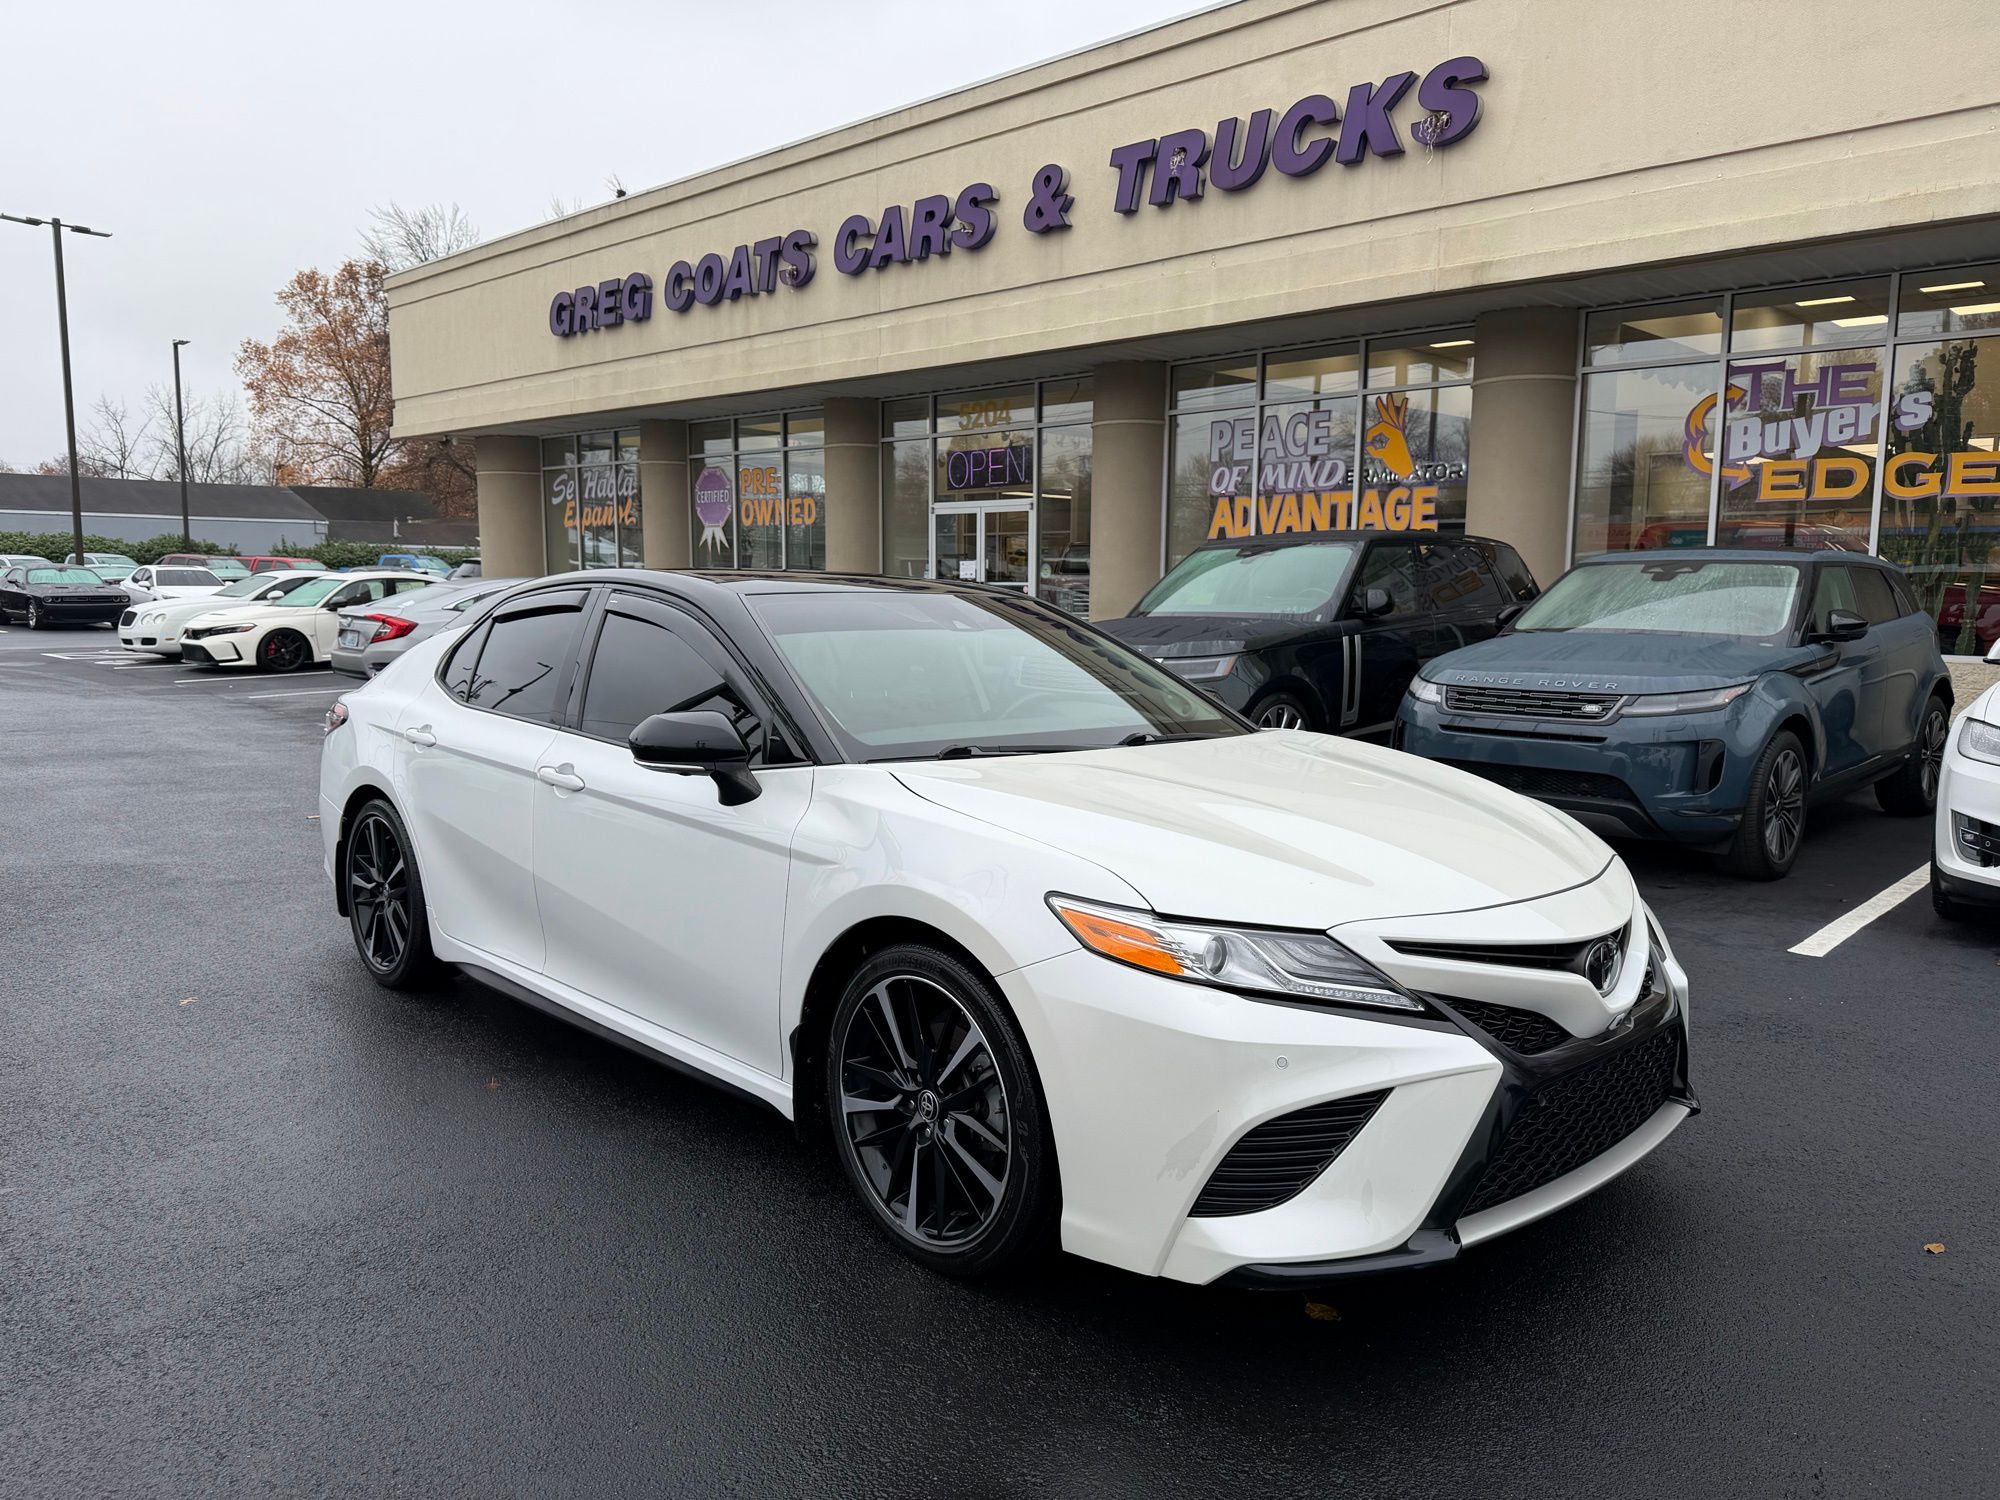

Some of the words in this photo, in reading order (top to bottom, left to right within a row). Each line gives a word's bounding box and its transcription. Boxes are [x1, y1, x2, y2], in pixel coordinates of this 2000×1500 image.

[549, 272, 653, 337] GREG
[664, 229, 818, 312] COATS
[834, 182, 1000, 276] CARS
[1023, 164, 1075, 234] &
[1109, 56, 1490, 216] TRUCKS
[1729, 361, 1878, 413] THE
[959, 400, 1011, 429] 5204
[1729, 391, 1933, 461] Buyers
[1210, 410, 1331, 461] PEACE
[948, 447, 1026, 488] OPEN
[1209, 465, 1248, 495] OF
[1259, 459, 1346, 492] MIND
[1757, 451, 2000, 502] EDGE
[552, 474, 575, 504] Se
[697, 489, 730, 504] CERTIFIED
[741, 498, 817, 526] OWNED
[1208, 486, 1439, 539] ADVANTAGE
[1455, 675, 1524, 685] RANGE
[1538, 679, 1619, 690] ROVER
